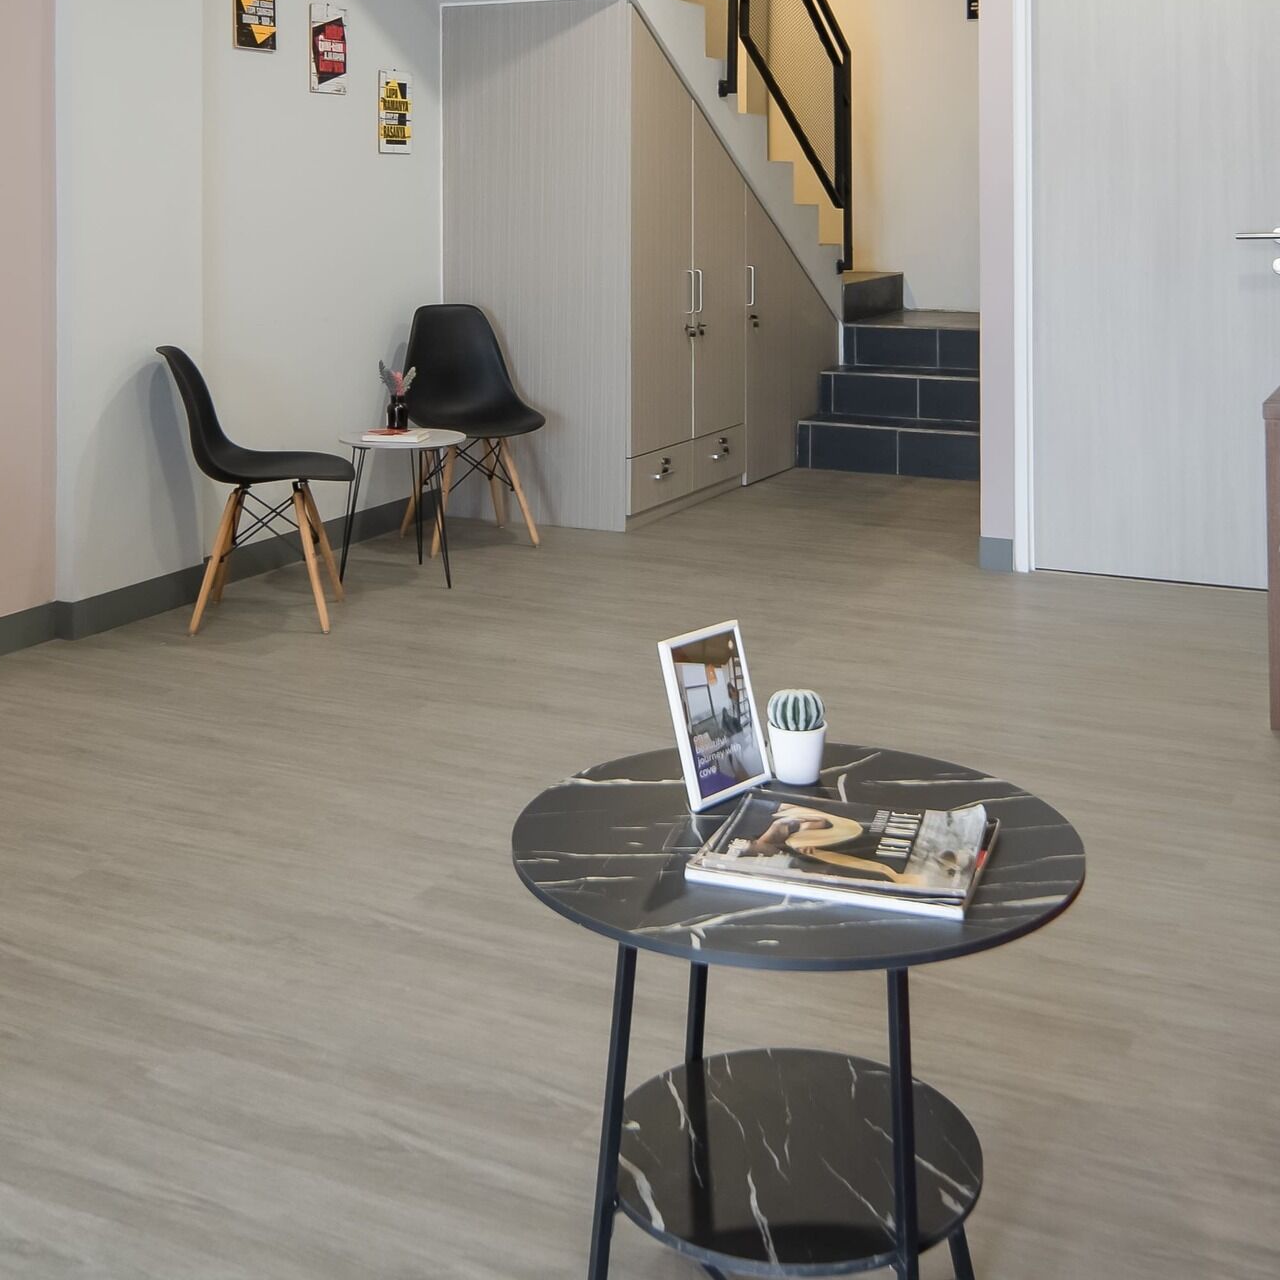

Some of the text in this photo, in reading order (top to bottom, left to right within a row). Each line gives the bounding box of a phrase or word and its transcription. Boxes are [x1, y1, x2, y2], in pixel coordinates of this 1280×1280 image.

[697, 743, 742, 768] journey with
[699, 765, 718, 778] cove
